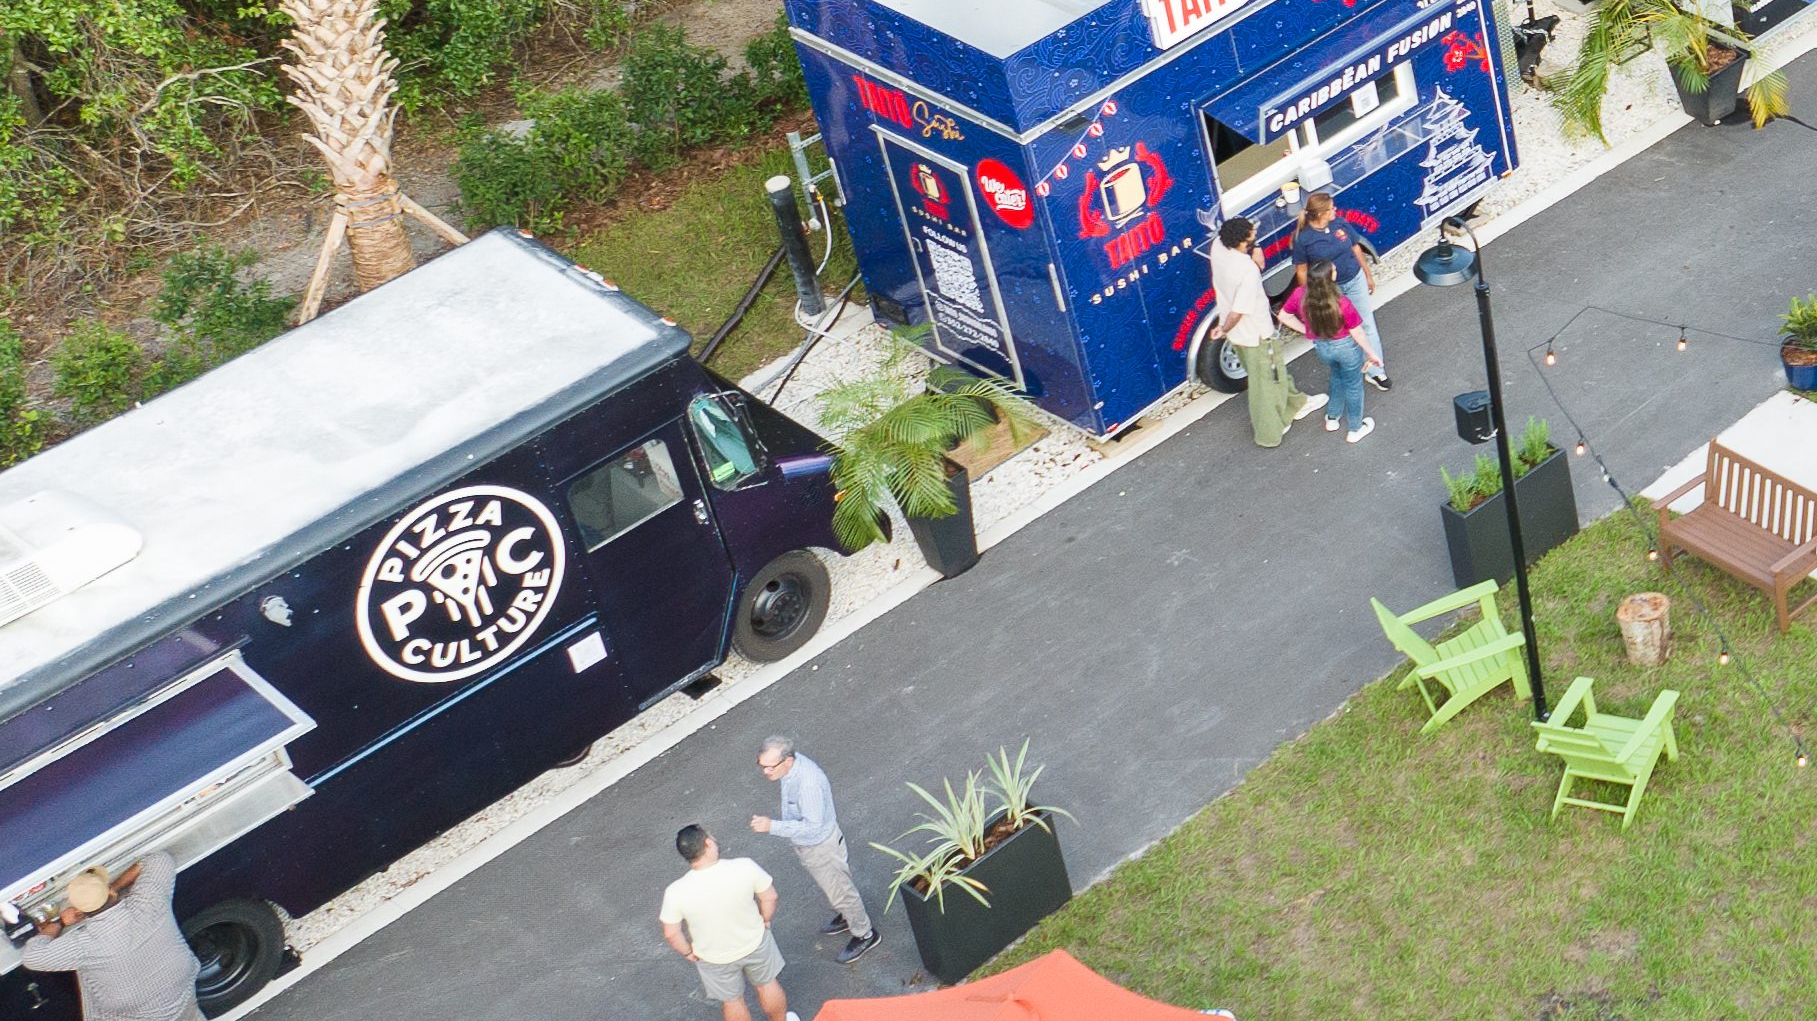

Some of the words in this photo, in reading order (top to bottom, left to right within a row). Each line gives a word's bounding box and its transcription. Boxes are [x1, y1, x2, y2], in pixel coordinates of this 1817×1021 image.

[1091, 264, 1149, 305] SUSHI
[1157, 237, 1193, 264] BAR
[377, 499, 503, 583] PIZZA
[401, 567, 551, 668] CULTURE
